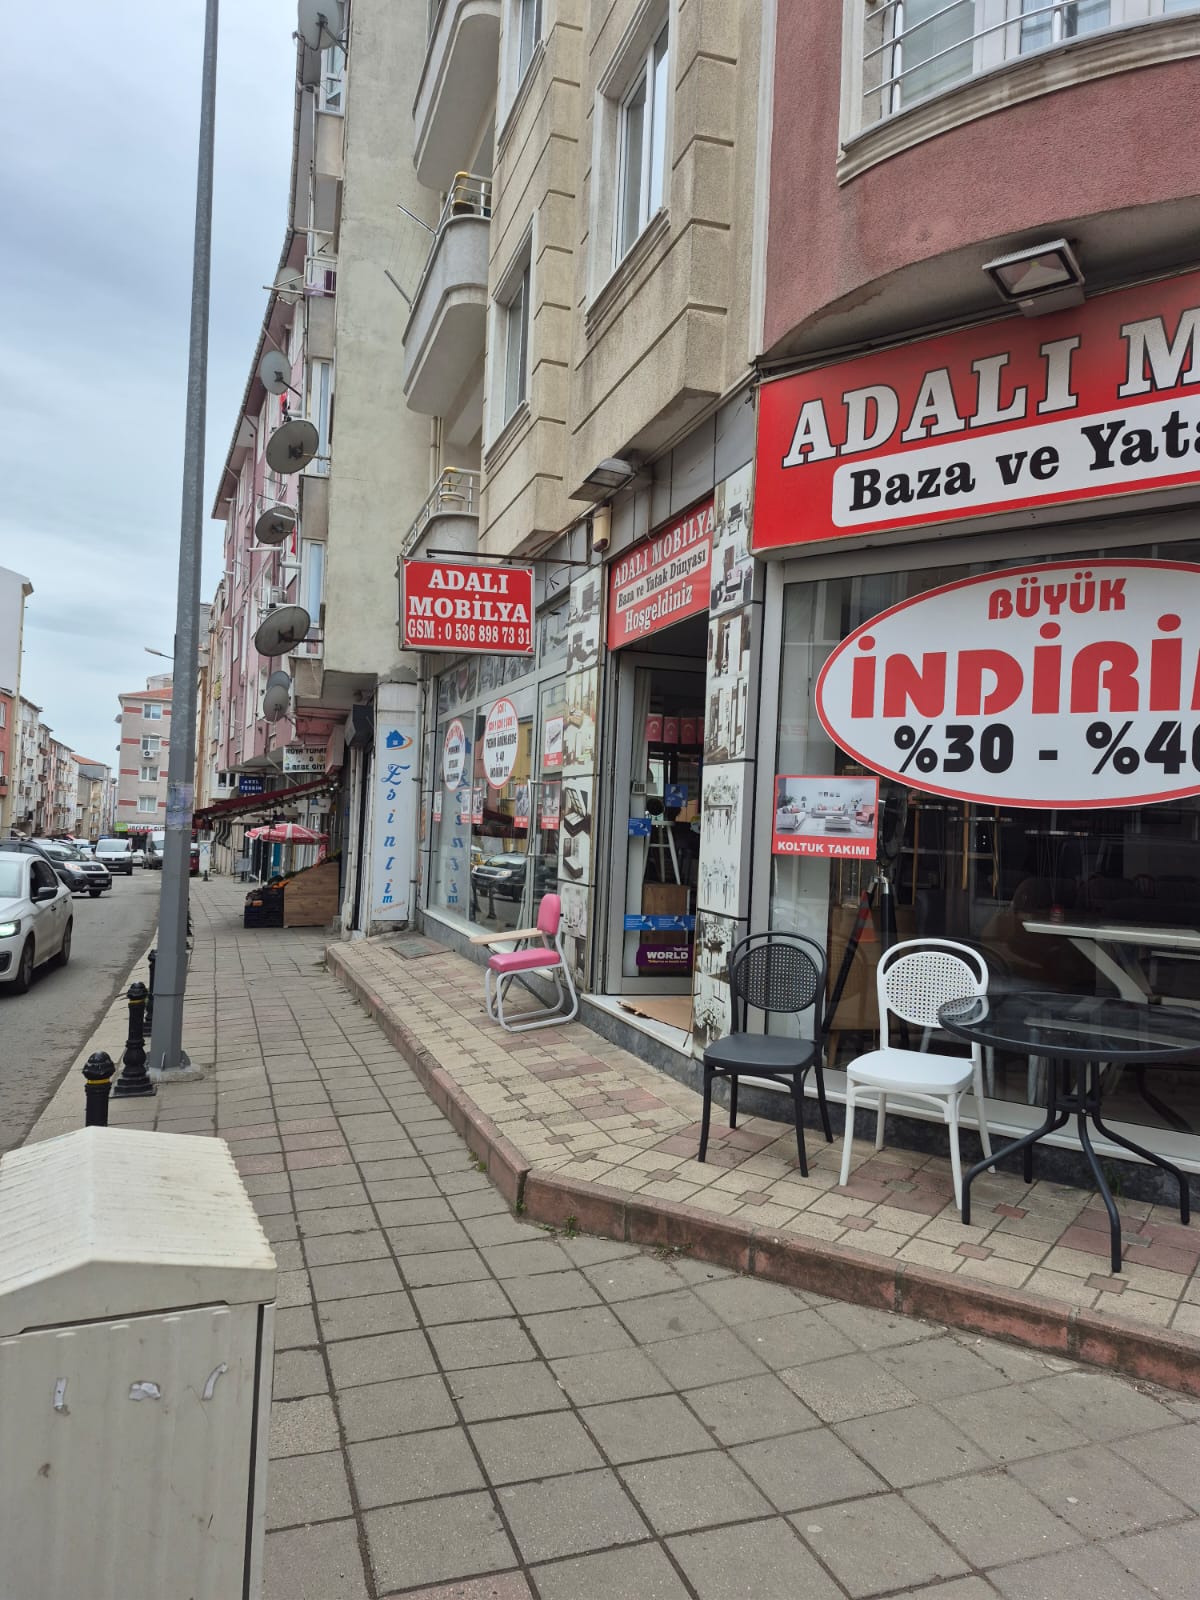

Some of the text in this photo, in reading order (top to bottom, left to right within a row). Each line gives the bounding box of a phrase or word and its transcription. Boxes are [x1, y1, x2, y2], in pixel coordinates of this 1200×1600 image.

[781, 334, 1082, 469] ADALI
[848, 410, 1200, 512] Baza ve Yat
[614, 506, 714, 589] ADALI MOBİLYA
[428, 569, 508, 594] ADALI
[636, 586, 644, 597] ve
[645, 568, 668, 593] Yatak
[669, 549, 706, 580] Dünyası
[988, 571, 1127, 620] BÜYÜK
[407, 619, 435, 639] GSM
[445, 622, 452, 640] 0
[455, 623, 475, 641] 536
[479, 625, 498, 643] 898
[502, 626, 515, 644] 73
[518, 627, 530, 645] 31
[408, 594, 529, 623] MOBİLYA
[624, 582, 693, 634] Hoşgeldiniz
[851, 613, 1200, 719] İNDİRİ
[894, 722, 1014, 774] %30
[1086, 721, 1200, 775] %4
[380, 763, 411, 904] Esintim
[777, 841, 870, 856] KOLTUK TAKIMI
[646, 951, 689, 960] WORLD
